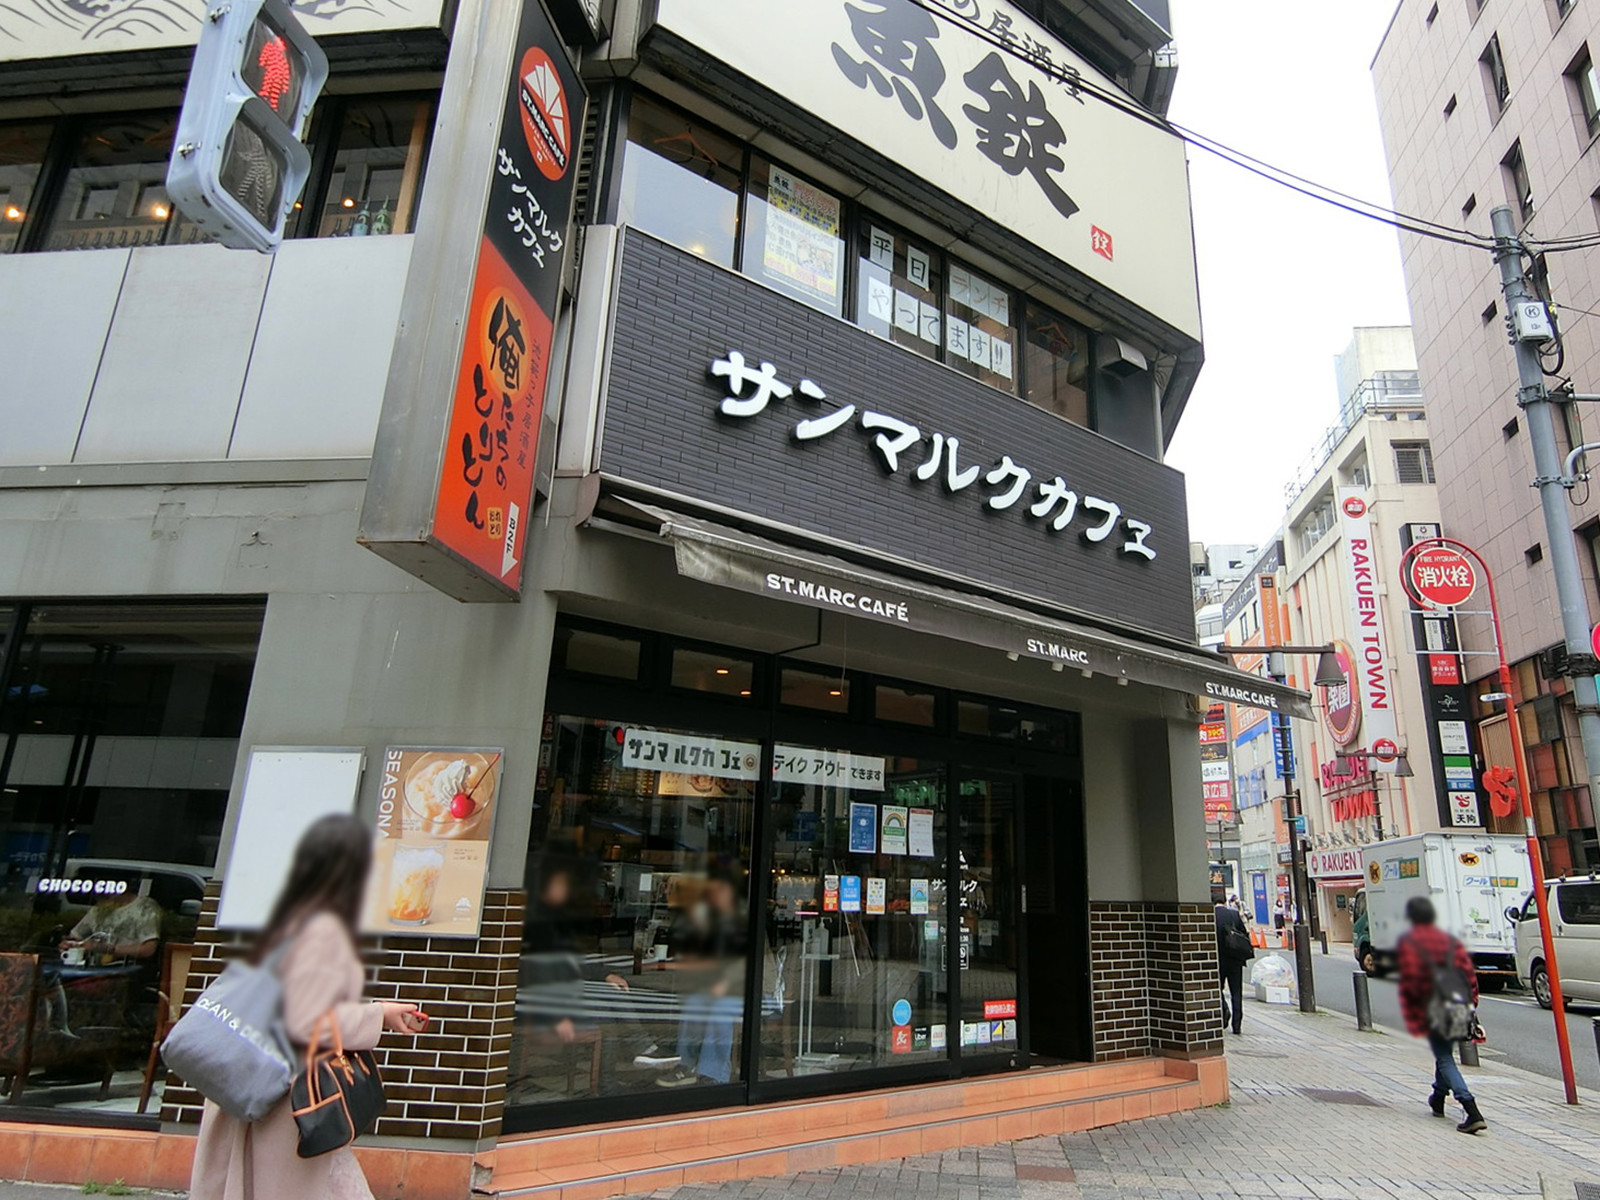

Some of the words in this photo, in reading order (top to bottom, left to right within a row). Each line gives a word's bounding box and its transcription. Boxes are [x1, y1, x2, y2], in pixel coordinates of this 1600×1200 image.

[498, 147, 564, 253] サンマルク
[507, 205, 545, 269] カフェ
[871, 234, 926, 283] 平日
[488, 295, 526, 491] 俺たちの
[462, 363, 495, 531] とりとん
[711, 351, 1158, 561] サンマルクカフェ
[505, 516, 516, 555] B2F
[766, 573, 857, 609] ST.MARC
[858, 596, 910, 623] CAFÉ
[1350, 538, 1378, 627] RAKUEN
[1416, 564, 1472, 588] 消火栓
[1026, 638, 1089, 665] ST.MARC
[1362, 632, 1389, 710] TOWN
[1205, 681, 1250, 702] ST.MARC
[1250, 692, 1279, 709] CAFÉ
[628, 737, 742, 771] サンマルクカフェ
[850, 767, 882, 782] できます
[1321, 850, 1358, 873] RAKUEN
[38, 878, 93, 894] CHOCO
[94, 880, 128, 894] CRO
[914, 1033, 927, 1041] Uber
